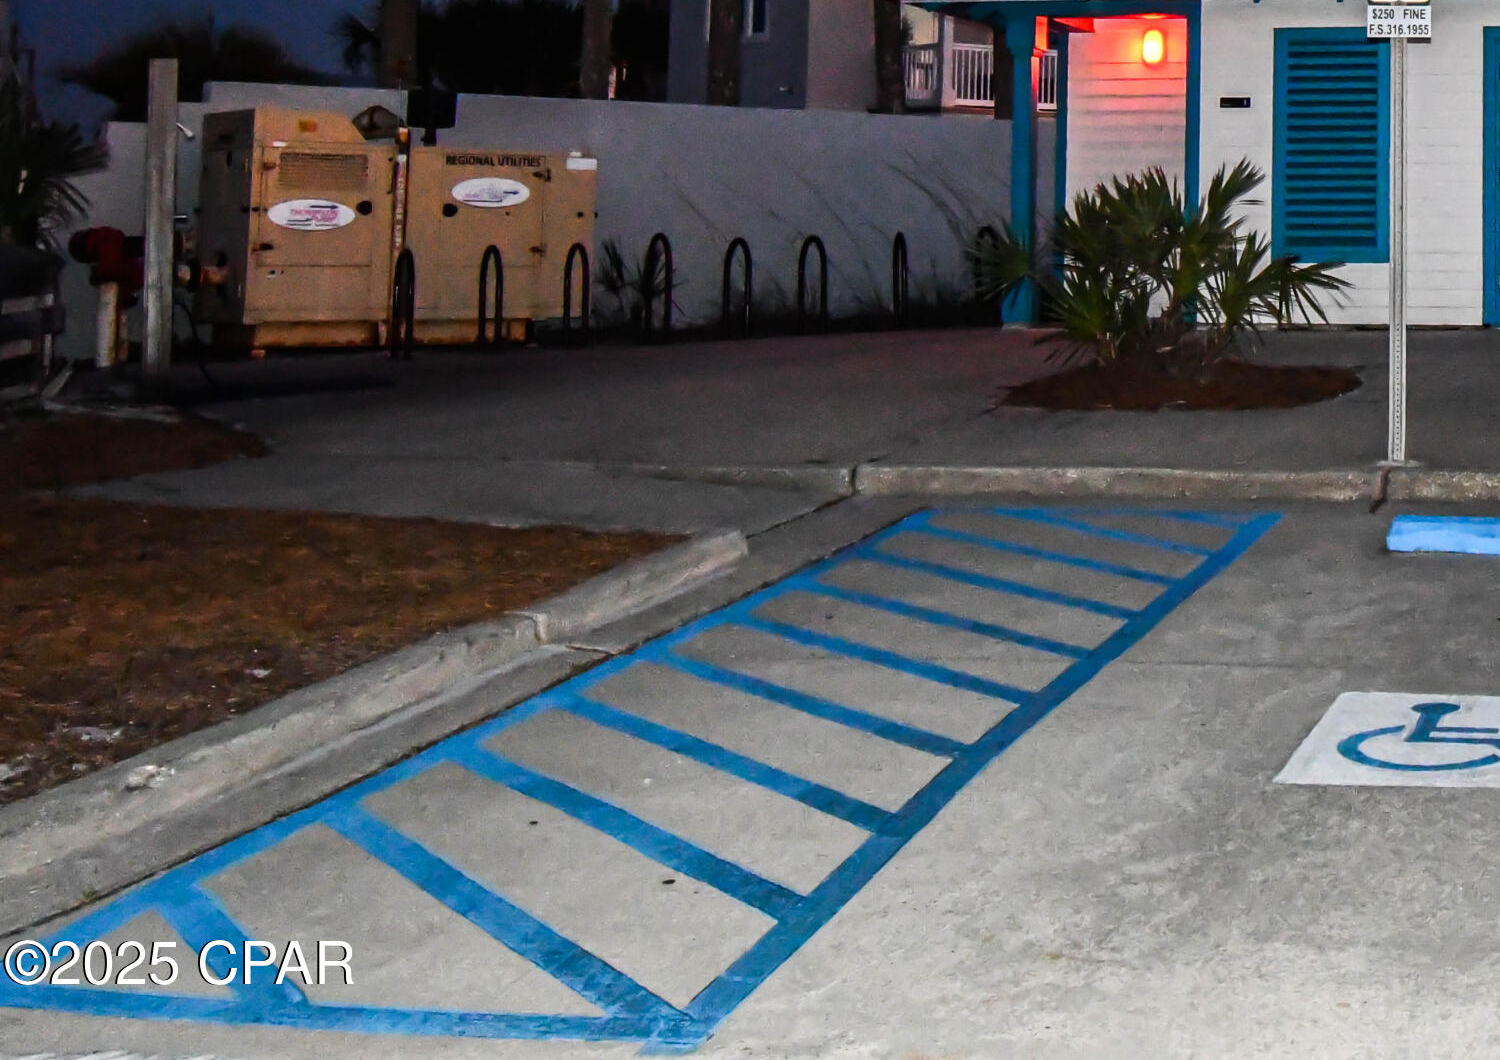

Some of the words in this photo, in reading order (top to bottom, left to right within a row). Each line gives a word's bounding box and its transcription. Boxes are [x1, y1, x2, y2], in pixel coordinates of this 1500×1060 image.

[1372, 8, 1394, 20] $250
[1403, 8, 1426, 20] FINE
[1369, 23, 1429, 36] F.S.316.1955
[446, 155, 495, 166] REGIONAL
[499, 155, 542, 167] UTILITIES
